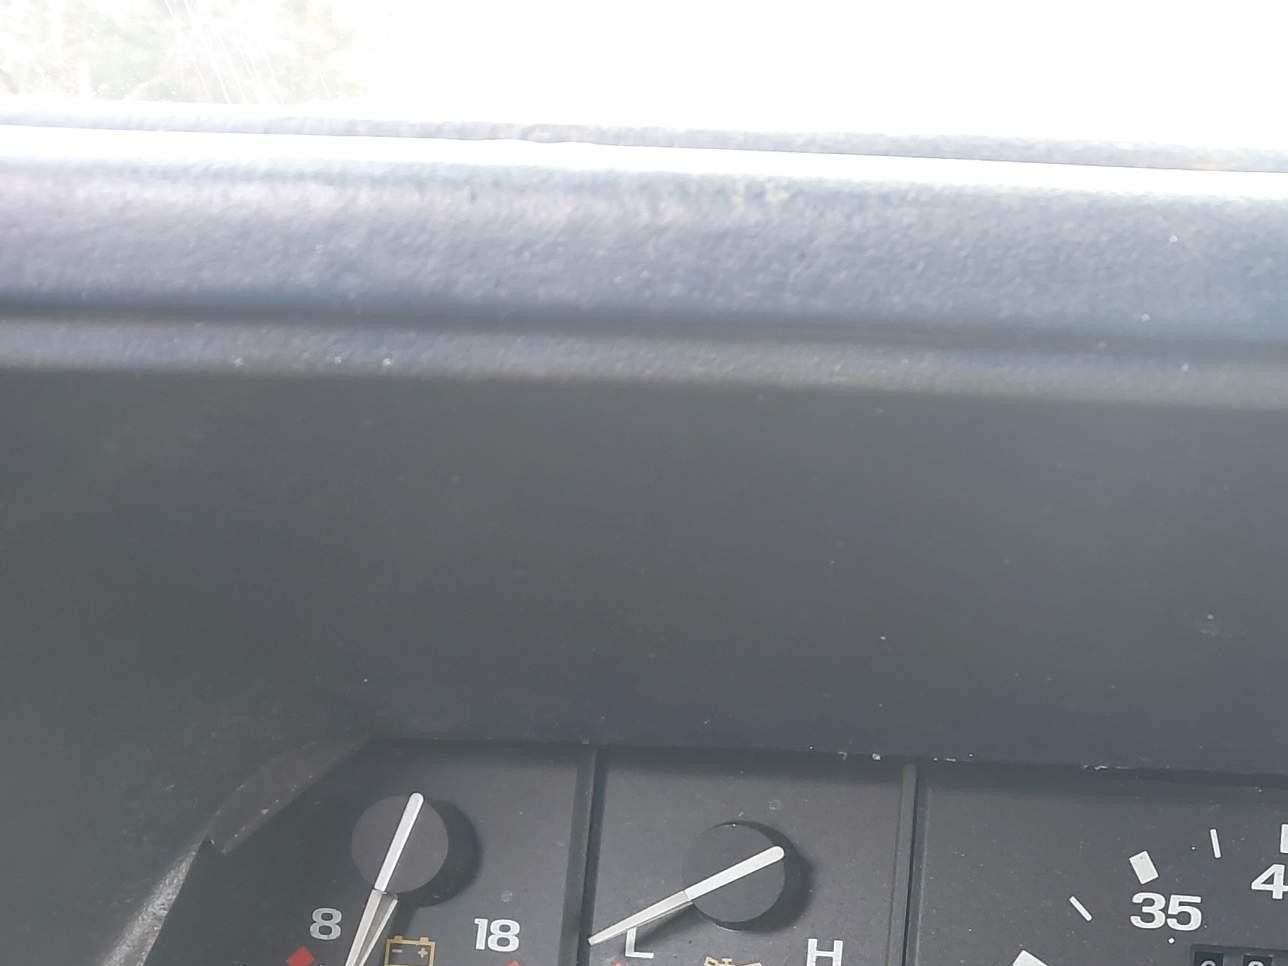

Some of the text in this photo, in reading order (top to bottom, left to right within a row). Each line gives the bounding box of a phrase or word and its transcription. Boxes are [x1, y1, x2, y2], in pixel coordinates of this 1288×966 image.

[310, 908, 342, 940] 8
[1131, 893, 1201, 930] 35
[475, 919, 520, 951] 18
[625, 926, 654, 959] L
